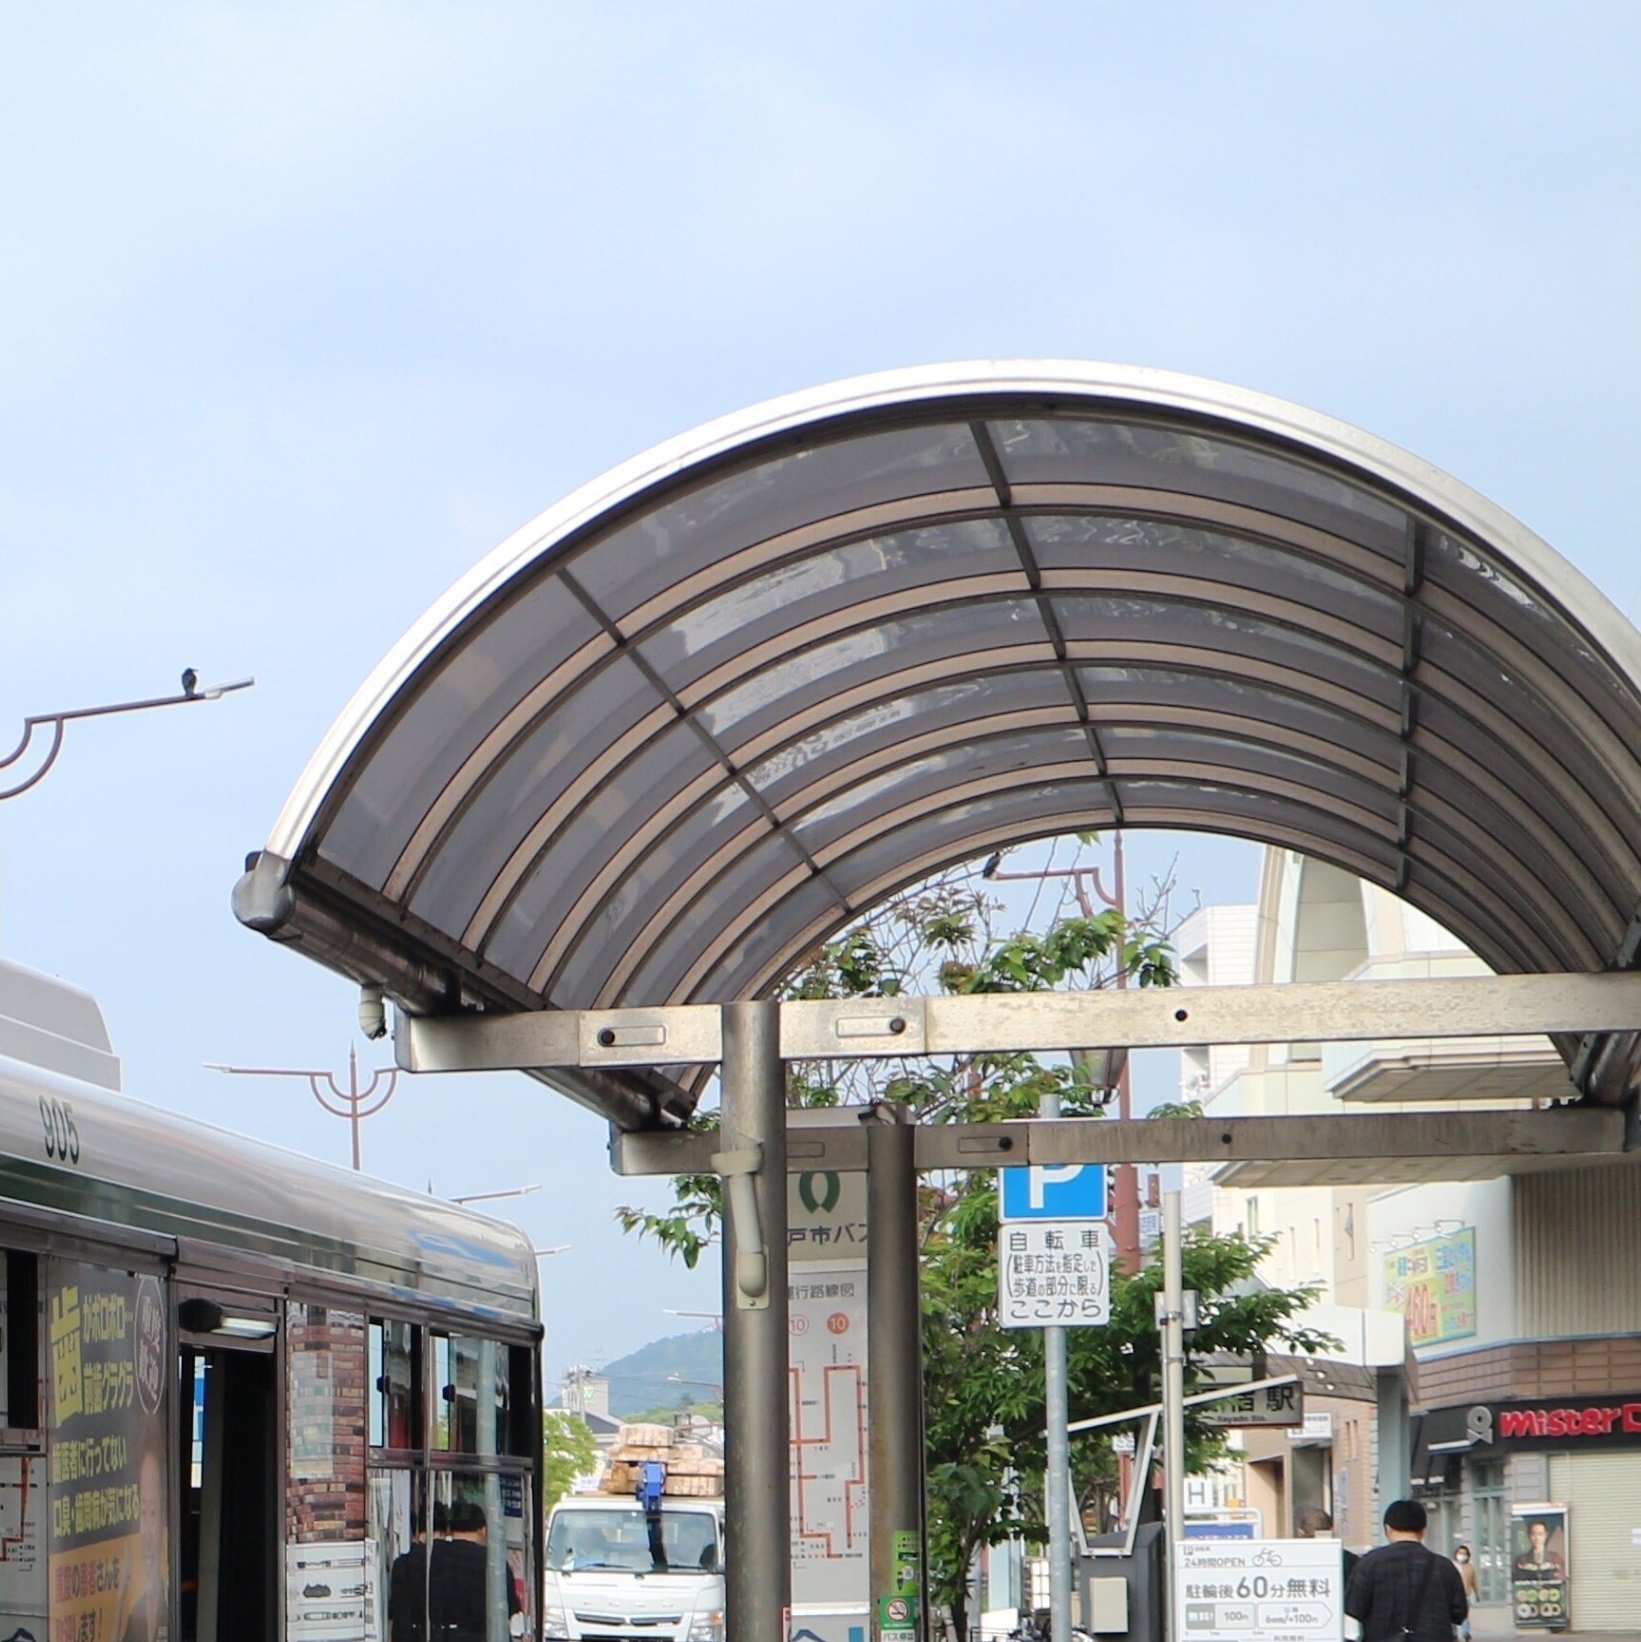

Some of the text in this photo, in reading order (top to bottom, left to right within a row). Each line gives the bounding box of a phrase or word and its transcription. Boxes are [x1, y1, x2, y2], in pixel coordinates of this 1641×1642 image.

[38, 1093, 79, 1165] 905
[1010, 1229, 1100, 1252] 自転車
[1010, 1299, 1102, 1319] ここから
[830, 1316, 847, 1330] 10
[1500, 1408, 1621, 1437] mister
[52, 1434, 127, 1485] 歯医者に行ってない
[1185, 1576, 1331, 1599] 駐輪後60分無料
